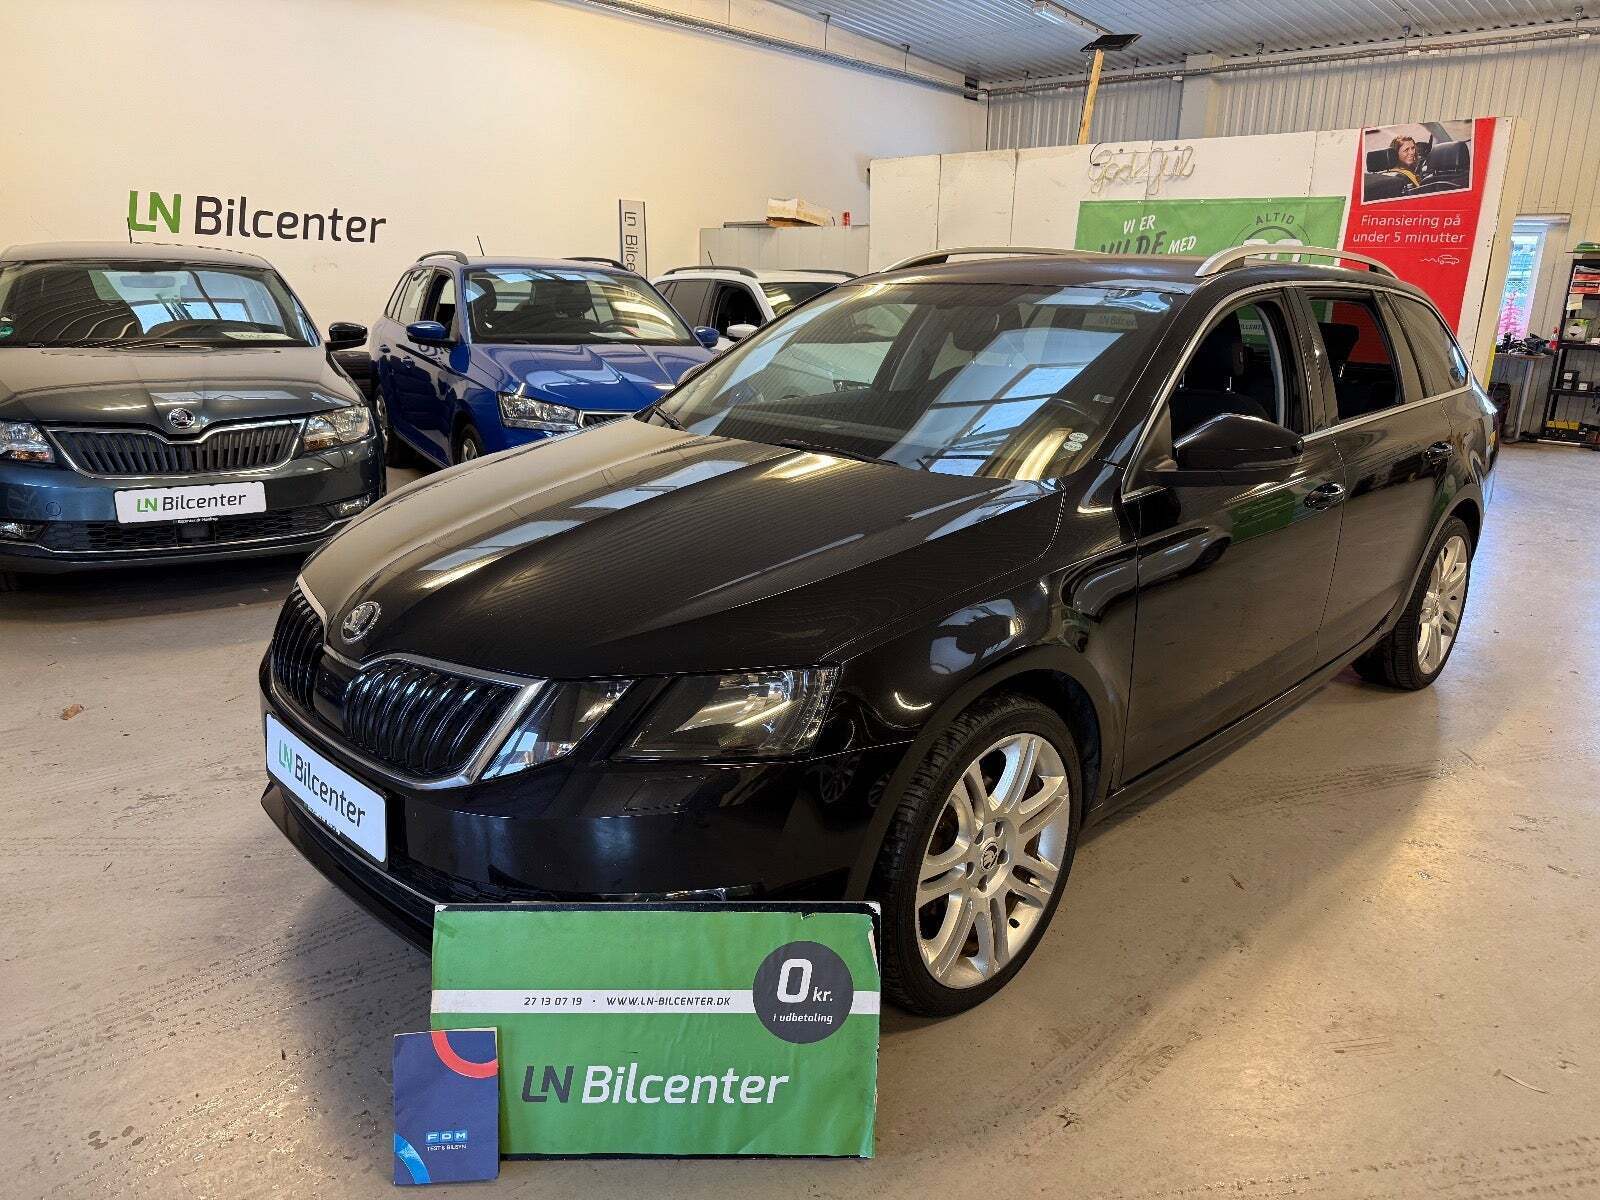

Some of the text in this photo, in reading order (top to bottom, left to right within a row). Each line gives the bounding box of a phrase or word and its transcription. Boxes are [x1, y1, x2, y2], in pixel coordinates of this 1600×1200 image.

[129, 190, 387, 243] LN Bilcenter
[1123, 214, 1156, 235] VI ER
[1256, 212, 1295, 226] ALTID
[1361, 213, 1462, 228] Finansiering på
[1167, 235, 1197, 255] MED
[1353, 231, 1465, 243] under 5 minutter
[136, 493, 247, 513] LN Bilcenter
[278, 739, 293, 774] LN
[294, 753, 366, 828] Bilcenter
[776, 958, 834, 1004] 0 kr.
[524, 996, 731, 1006] 27 13 07 19 WWW.LN-BILCENTER.DK
[779, 1012, 834, 1025] udbetaling
[522, 1062, 789, 1104] LN Bilcenter
[427, 1132, 466, 1142] FDM
